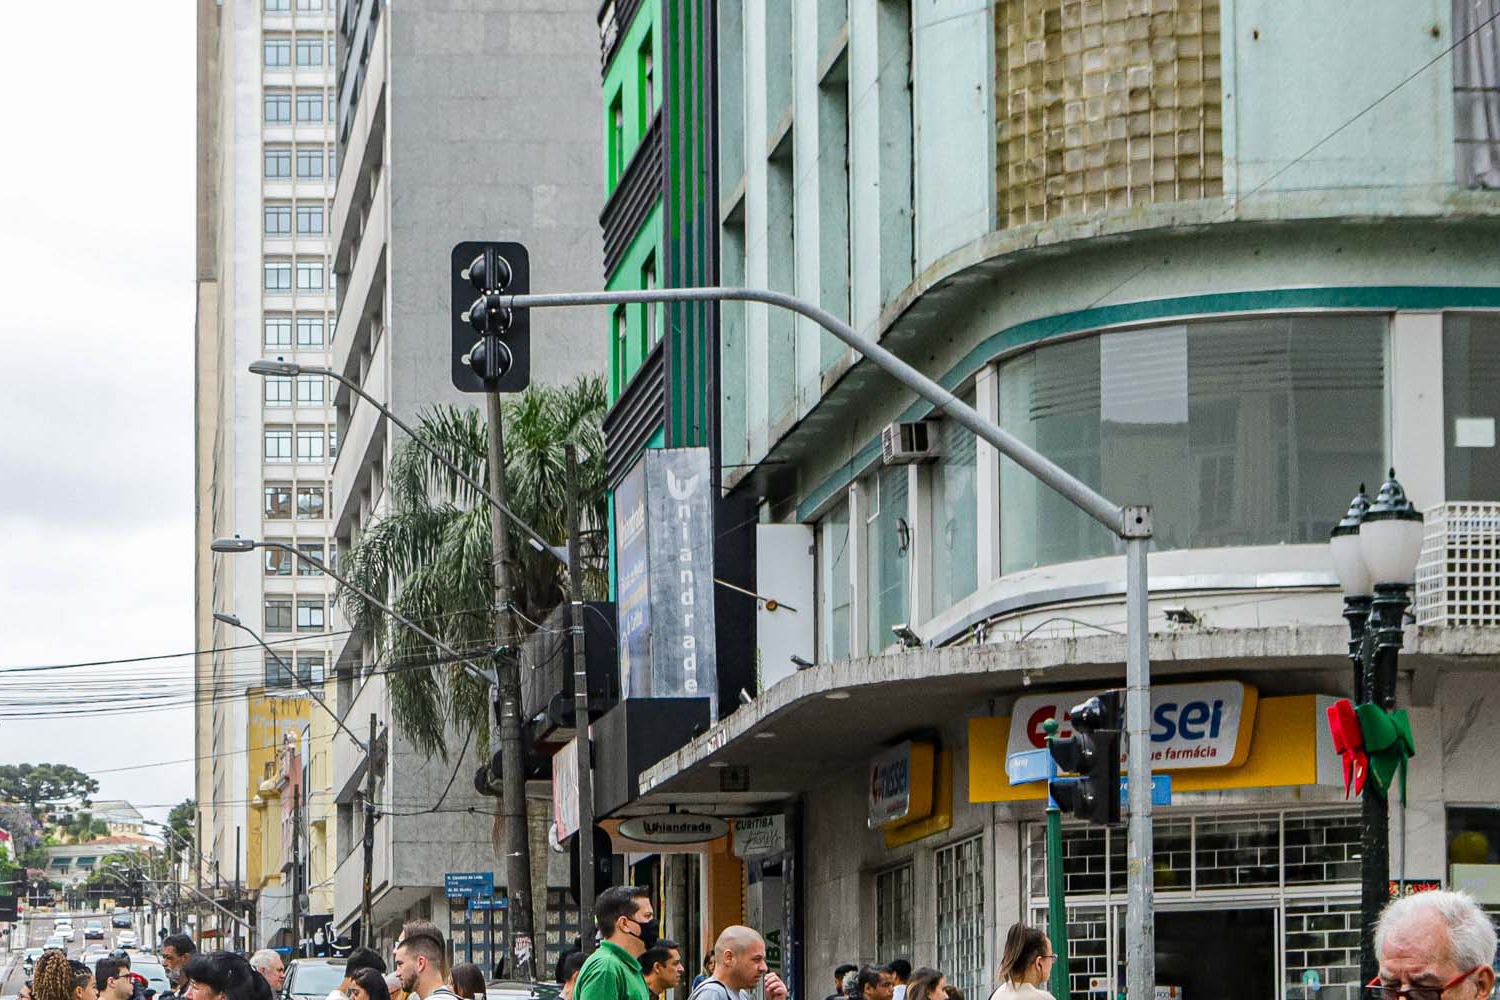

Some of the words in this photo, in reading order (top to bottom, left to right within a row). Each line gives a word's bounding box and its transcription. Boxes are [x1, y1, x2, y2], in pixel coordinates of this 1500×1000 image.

[666, 469, 701, 692] Uniandrade
[1165, 746, 1217, 762] farmácia
[736, 816, 774, 831] CURITIBA
